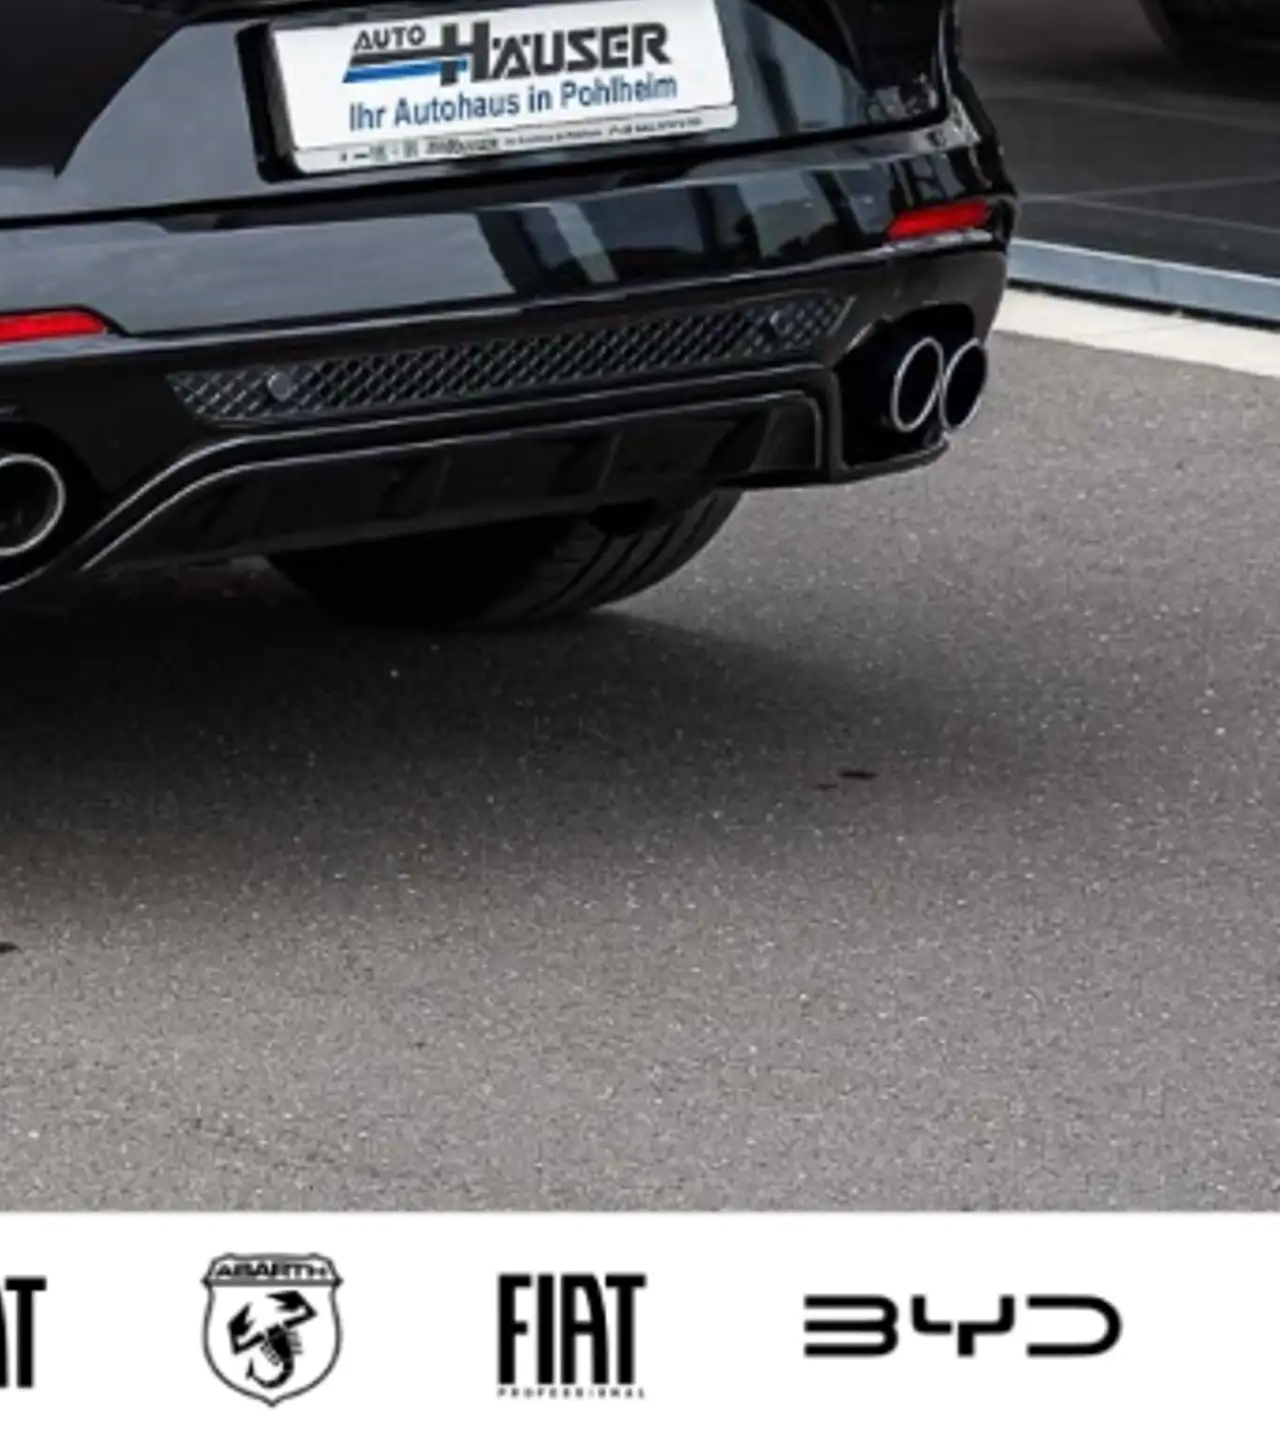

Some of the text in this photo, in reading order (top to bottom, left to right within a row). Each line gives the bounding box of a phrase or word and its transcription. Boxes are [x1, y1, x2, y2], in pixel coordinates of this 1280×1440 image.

[353, 21, 672, 87] AUTO HÄUSER
[348, 72, 678, 132] Ihr Autohaus in Pohlheim
